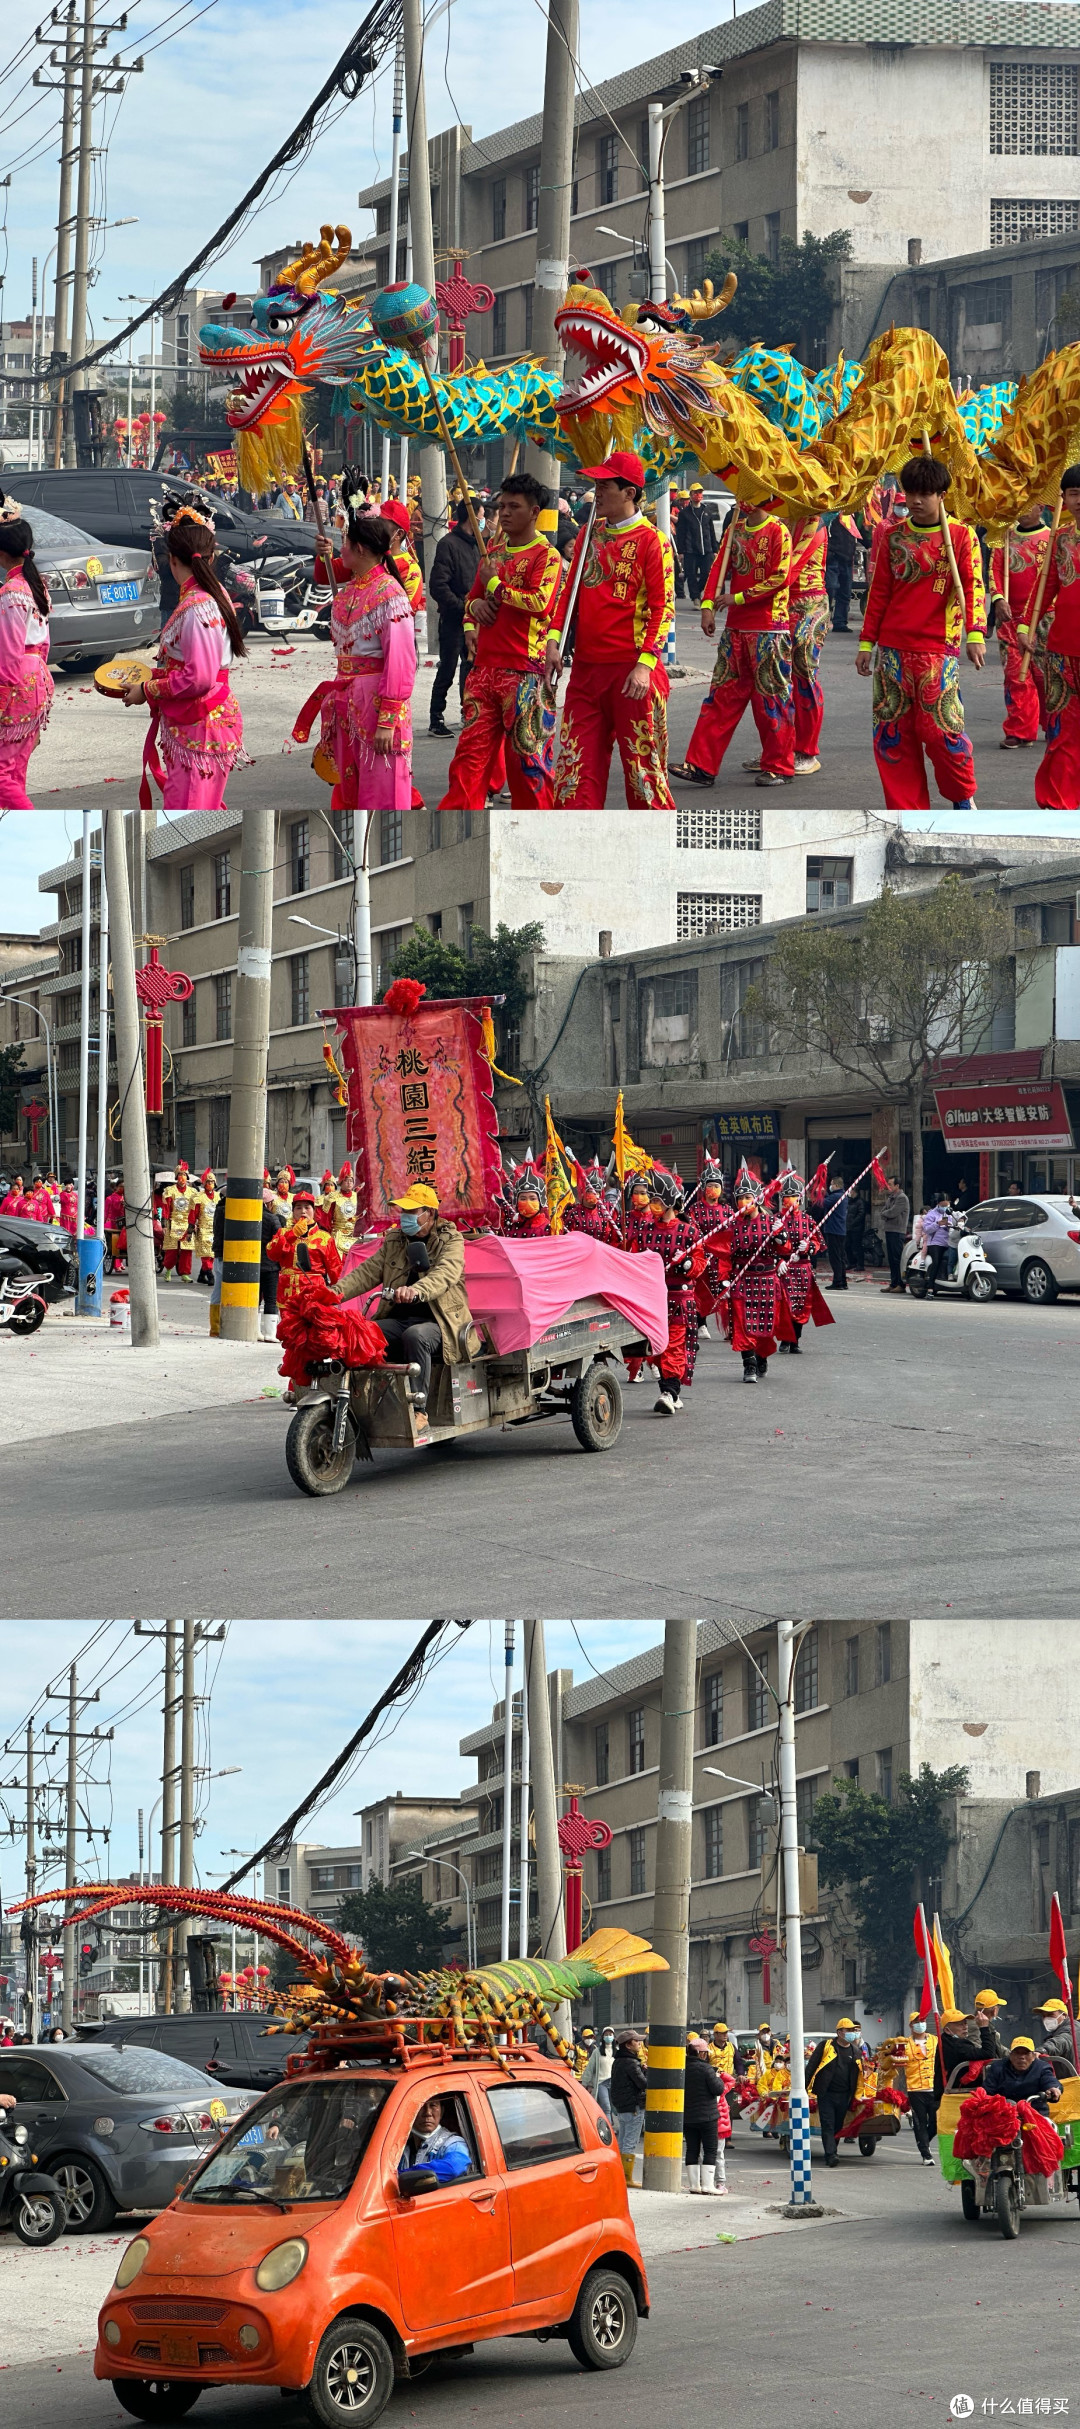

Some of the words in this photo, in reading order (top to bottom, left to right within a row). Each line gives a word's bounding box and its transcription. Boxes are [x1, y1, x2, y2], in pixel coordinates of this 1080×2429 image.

[613, 541, 637, 601] 龍獅團
[982, 1104, 1050, 1123] 大华智能安防
[718, 1115, 774, 1135] 金英帆布店
